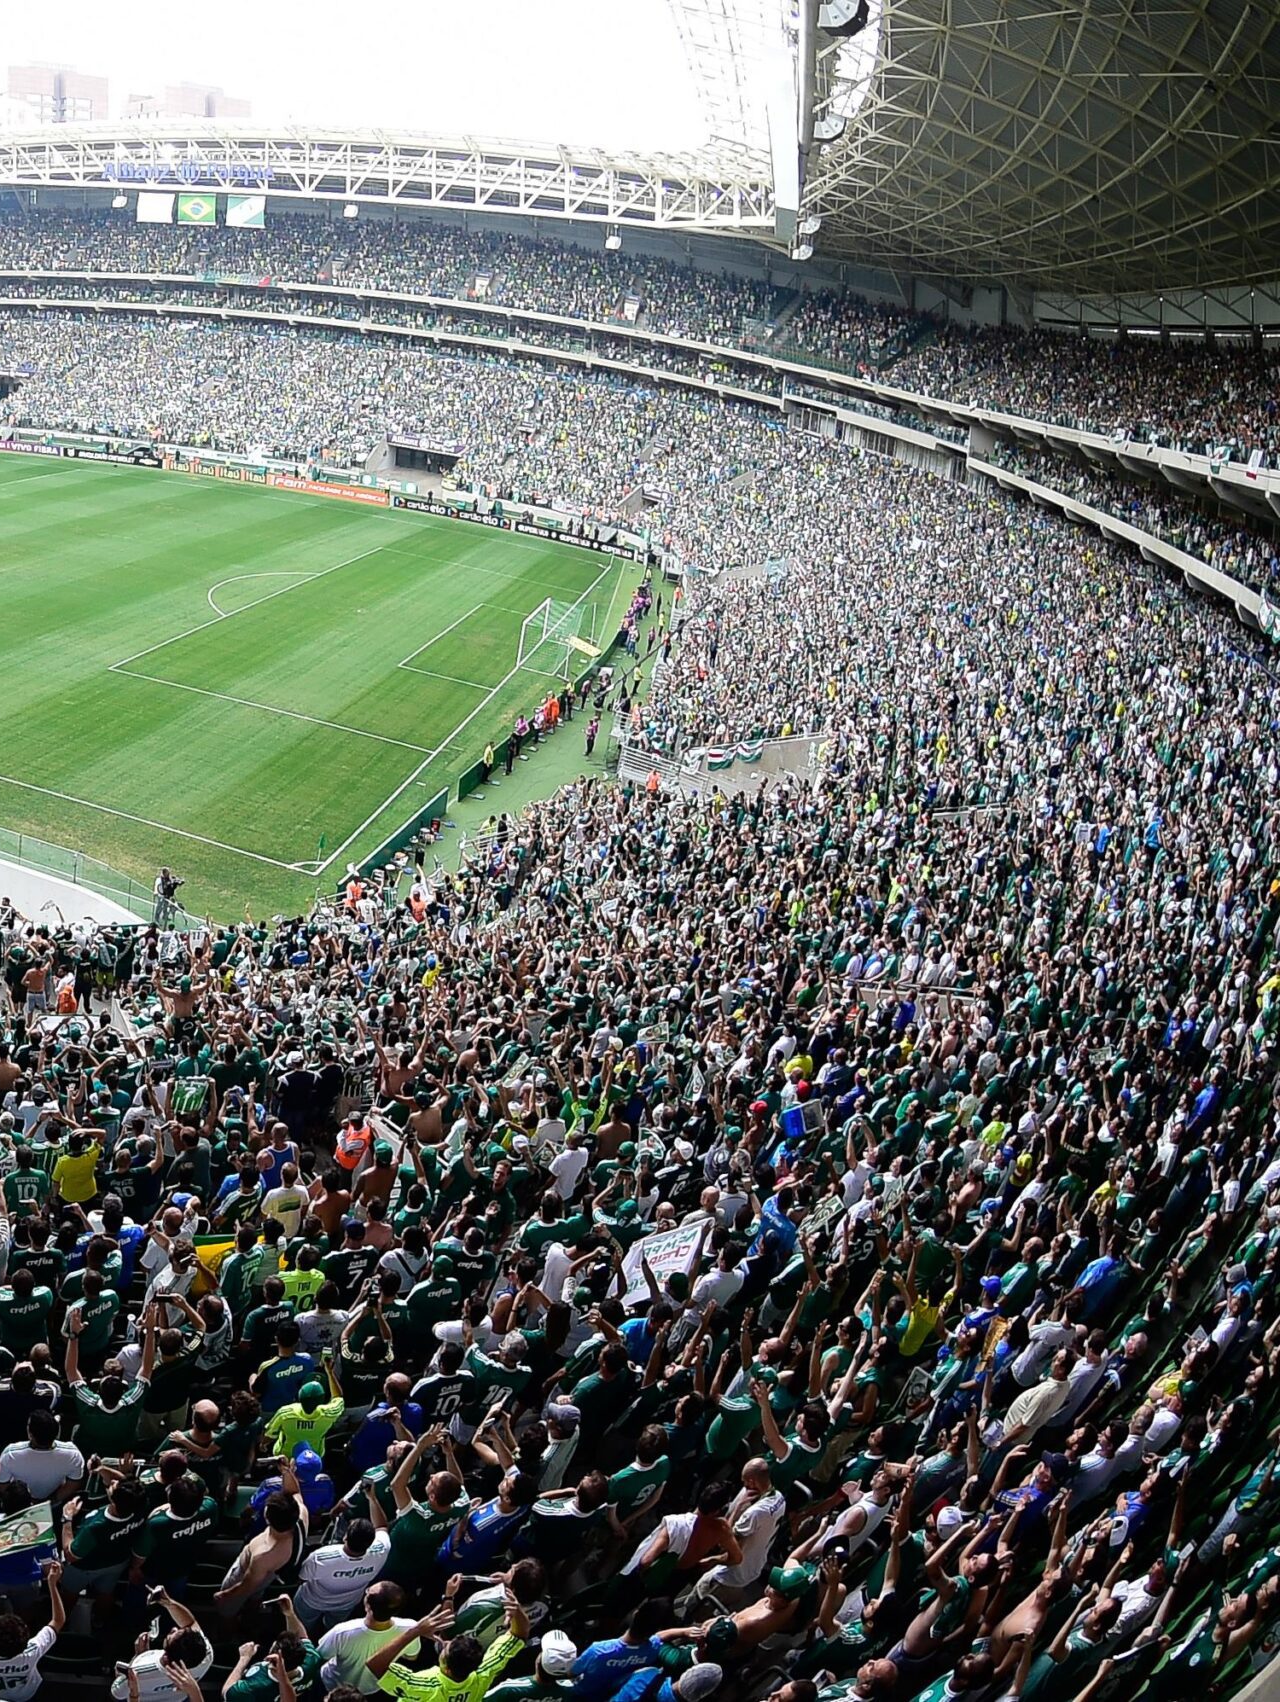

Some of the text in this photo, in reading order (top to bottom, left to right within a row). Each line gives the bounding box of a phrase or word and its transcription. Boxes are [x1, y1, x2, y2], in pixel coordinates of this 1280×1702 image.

[102, 162, 171, 180] Allianz
[16, 1183, 38, 1201] 10
[26, 1256, 55, 1267] crefisa
[346, 1269, 364, 1290] 7
[9, 1301, 41, 1315] crefisa
[87, 1300, 114, 1319] crefisa
[275, 1363, 304, 1379] crefisa
[431, 1394, 461, 1417] 10
[296, 1420, 316, 1431] FIAT
[172, 1517, 212, 1540] crefisa
[333, 1564, 375, 1580] crefisa
[605, 1654, 648, 1669] crefisa
